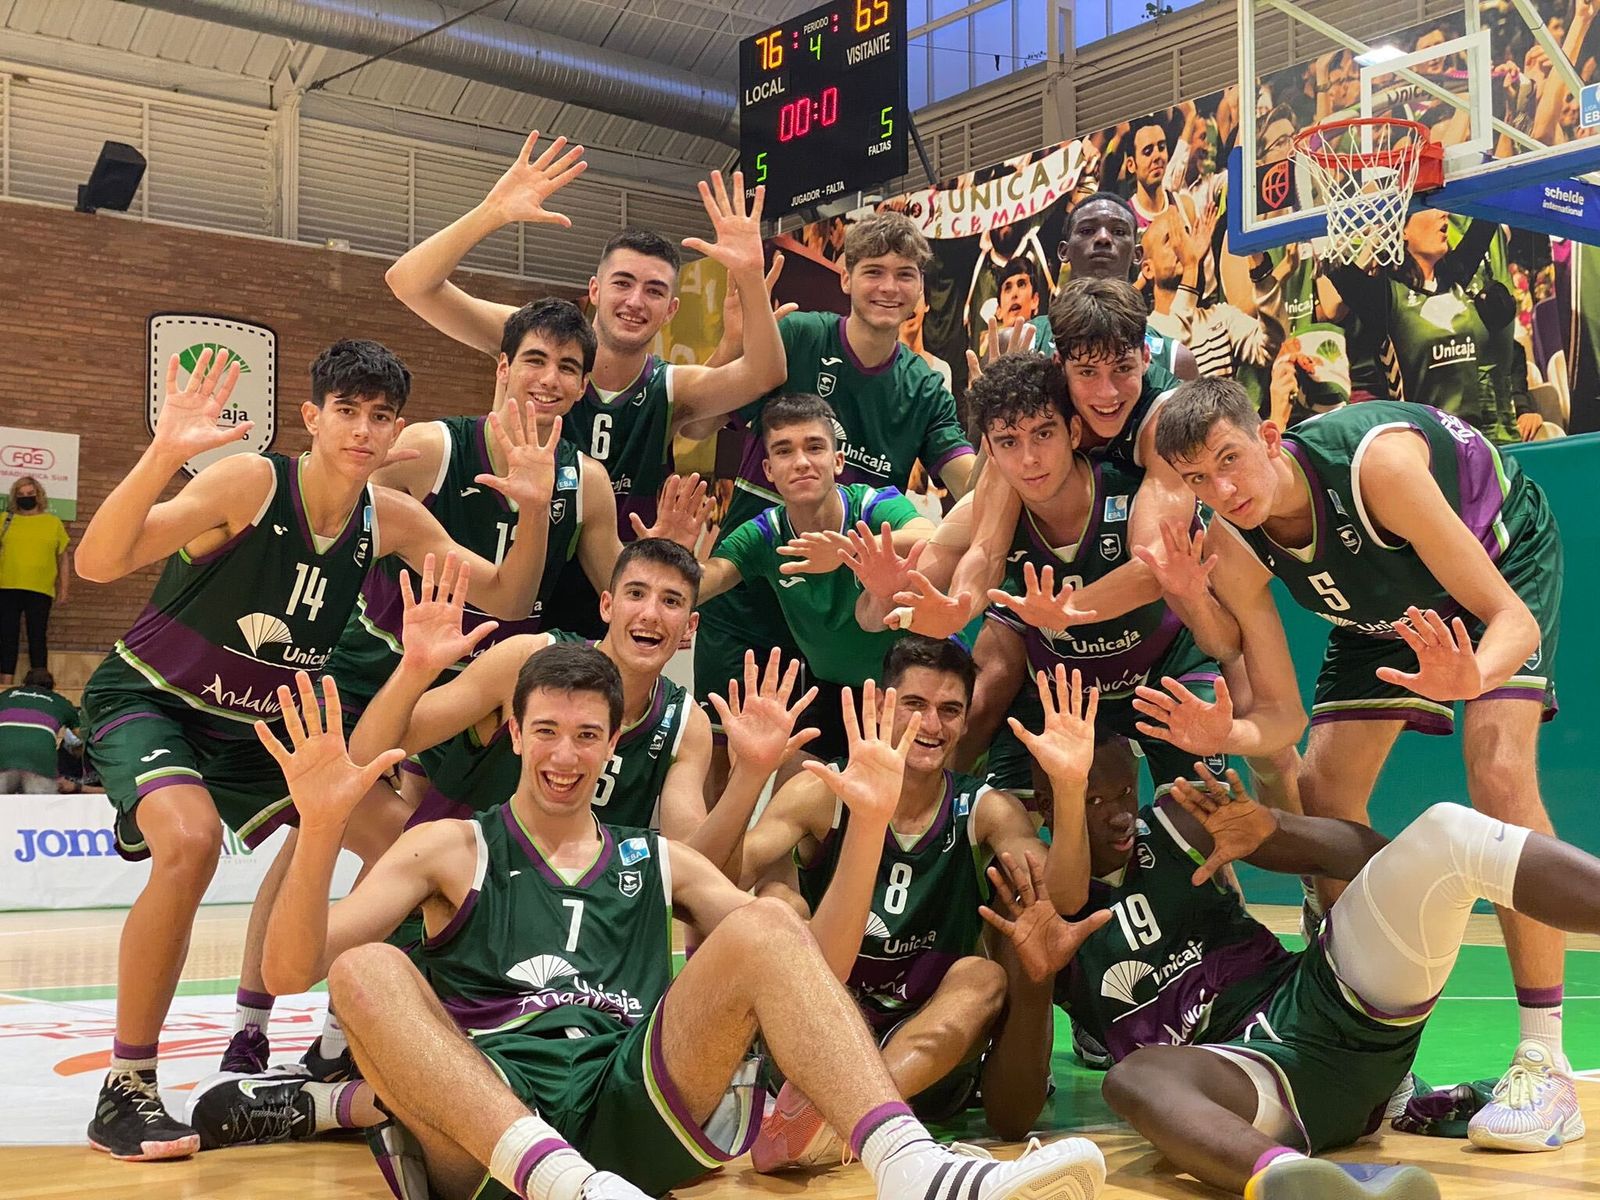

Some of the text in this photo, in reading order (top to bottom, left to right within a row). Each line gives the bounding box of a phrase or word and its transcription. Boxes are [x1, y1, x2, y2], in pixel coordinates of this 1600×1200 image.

[803, 16, 829, 35] PERIODO
[855, 0, 889, 33] 65
[755, 30, 783, 71] 76
[809, 34, 822, 61] 4
[846, 32, 891, 66] VISITANTE
[745, 77, 786, 107] LOCAL
[779, 87, 838, 142] 00:0
[880, 106, 893, 139] 5
[1584, 110, 1600, 124] EB
[868, 140, 892, 157] FALTAS
[756, 152, 768, 183] 5
[790, 190, 821, 207] JUGADOR
[826, 181, 845, 197] FALTA
[1542, 199, 1584, 217] international
[1544, 186, 1585, 206] schelde
[1432, 336, 1476, 361] Unicaja
[591, 413, 613, 460] 6
[841, 442, 892, 473] Unicaja
[559, 480, 574, 488] EBA
[494, 521, 518, 568] 1
[285, 562, 328, 622] 14
[1308, 571, 1351, 611] 5
[282, 644, 333, 667] Unicaj
[1072, 630, 1141, 654] Unicaja
[200, 673, 301, 713] Andaluc
[14, 828, 119, 863] Jom
[883, 862, 913, 915] 8
[562, 898, 584, 953] 7
[1110, 893, 1162, 952] 19
[1152, 940, 1204, 986] Unicaj
[573, 975, 642, 1016] Unicaja
